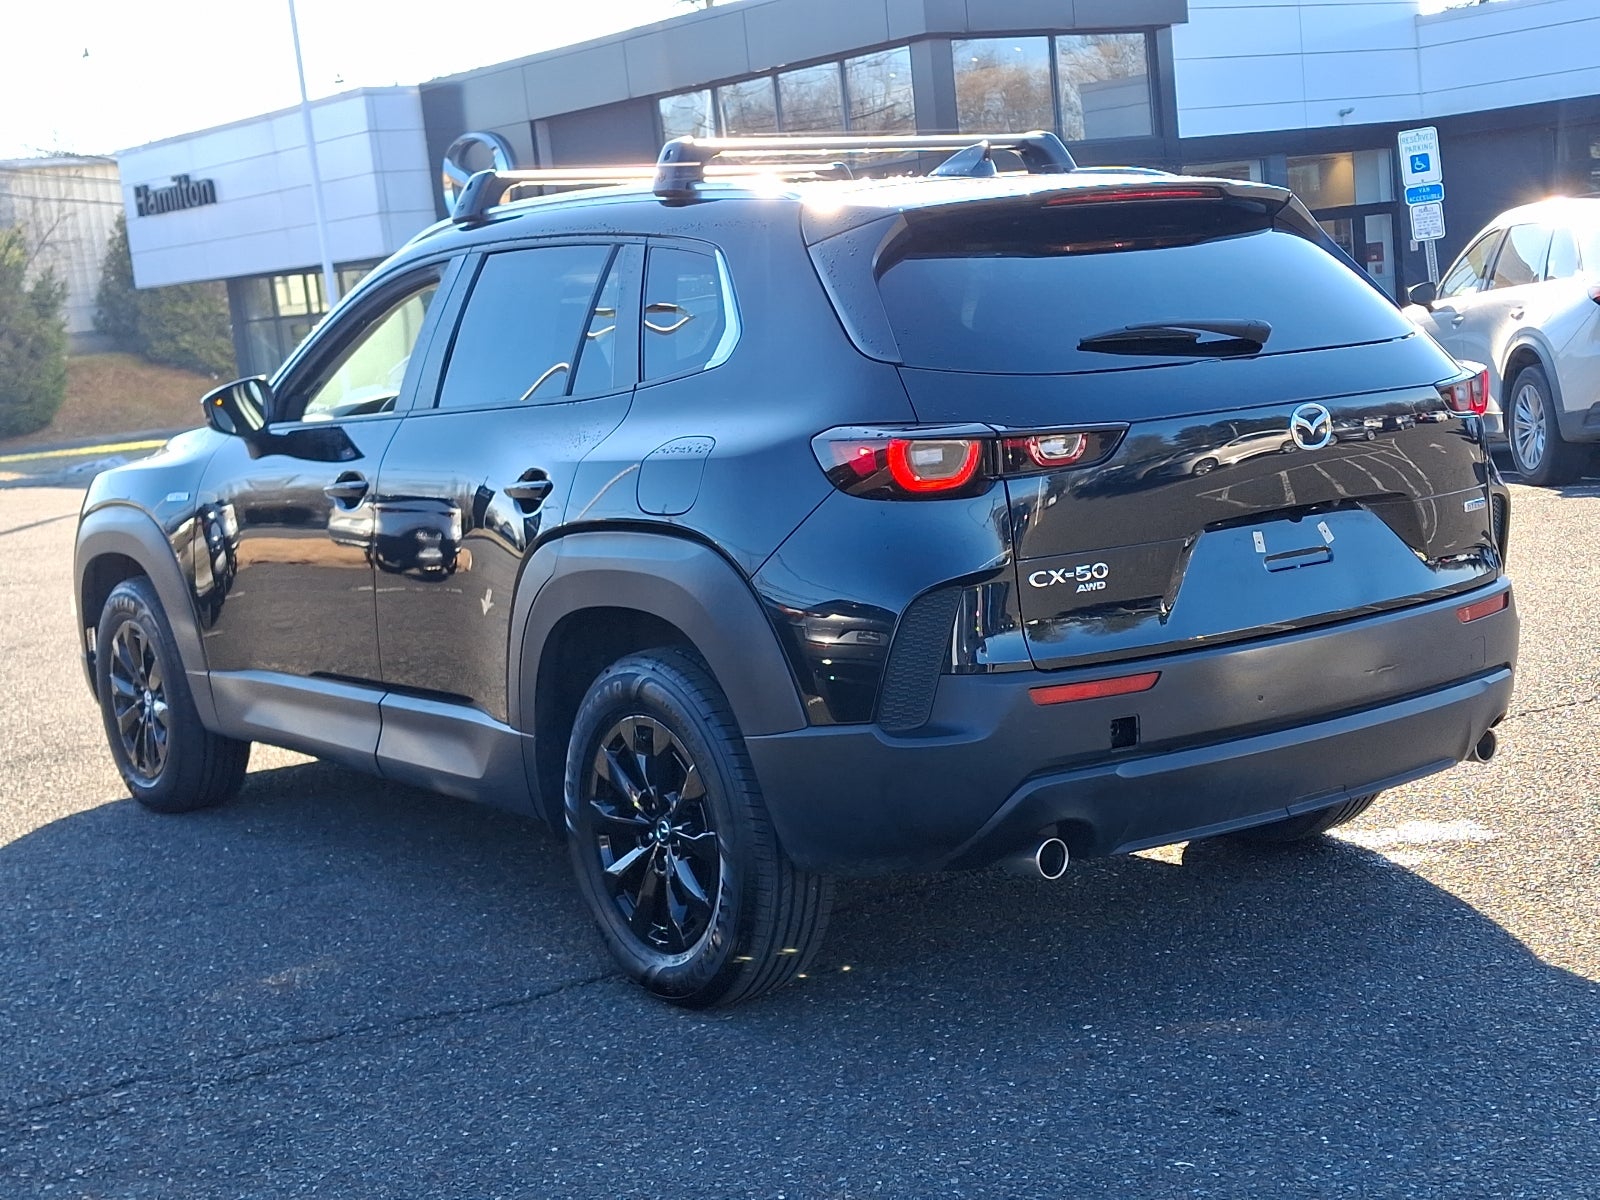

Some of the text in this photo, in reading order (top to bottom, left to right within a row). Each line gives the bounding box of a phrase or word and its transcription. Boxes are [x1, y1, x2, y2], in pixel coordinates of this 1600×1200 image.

[1401, 132, 1435, 144] RESERVED
[1404, 142, 1434, 153] PARKING
[134, 173, 217, 217] Hamilton
[1028, 562, 1109, 588] CX-50
[1075, 581, 1107, 594] AWD
